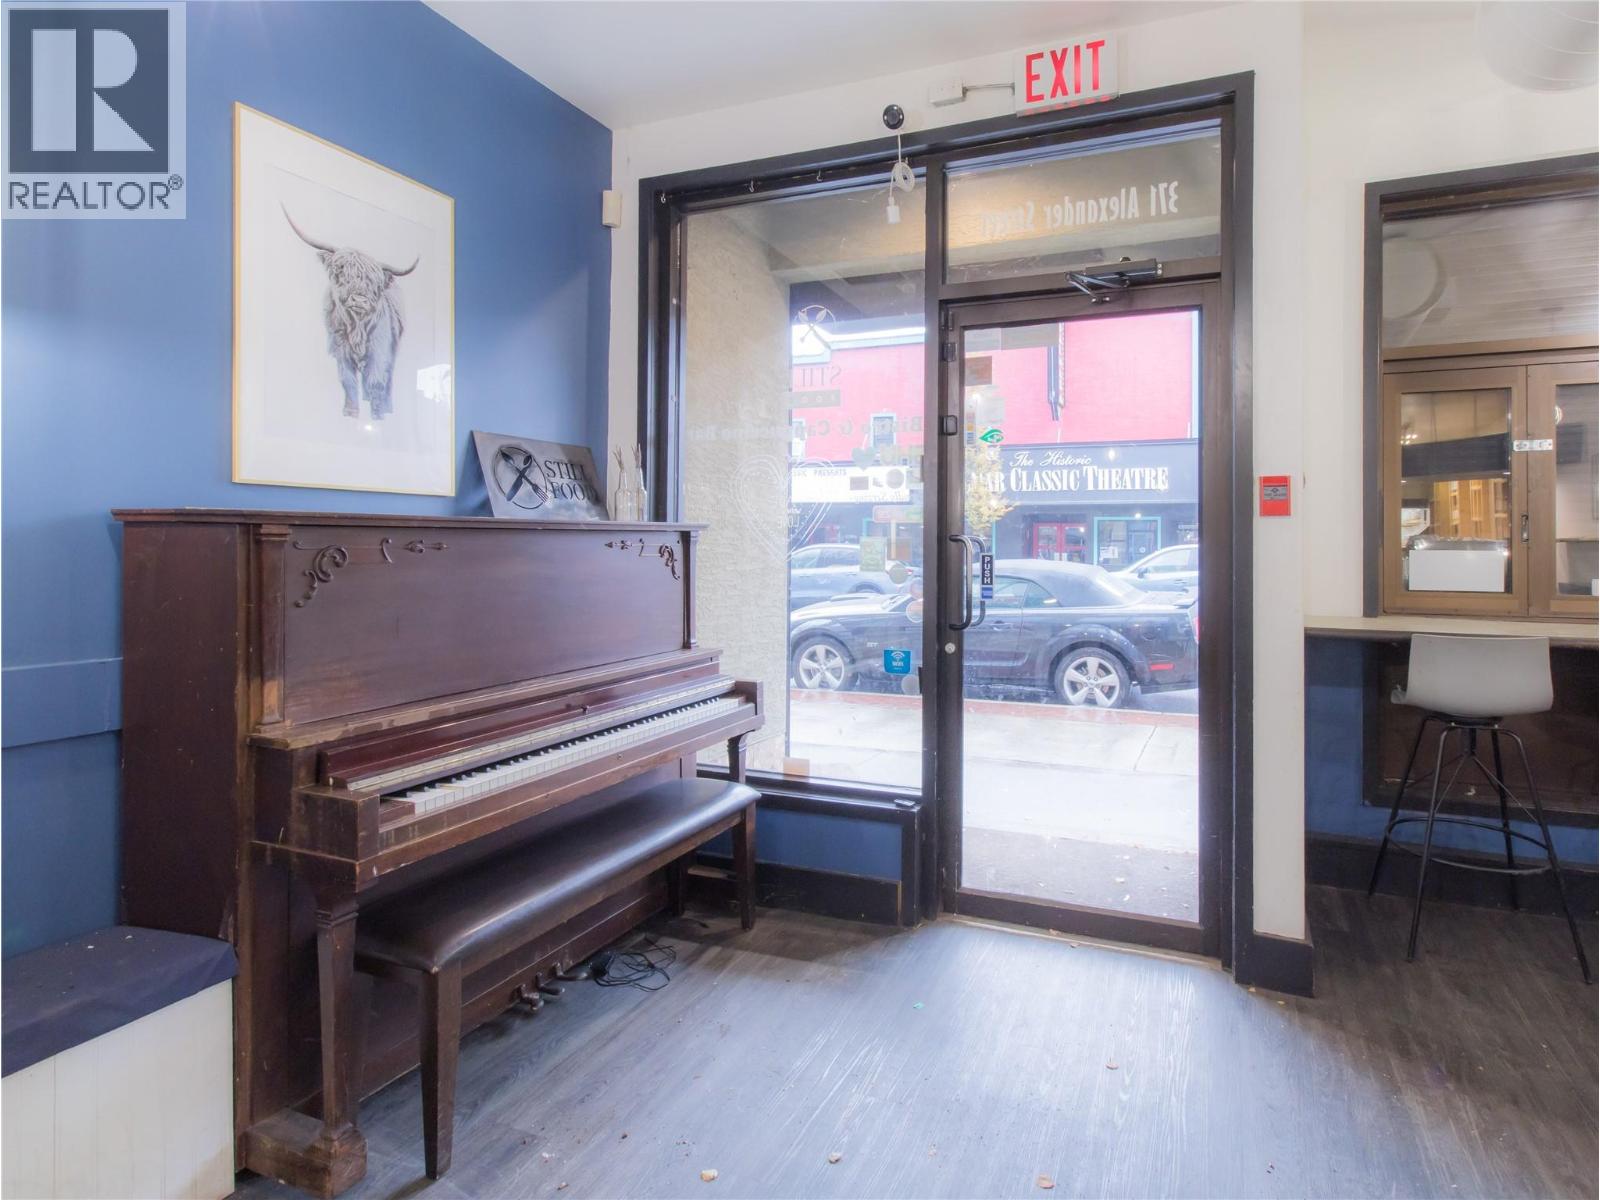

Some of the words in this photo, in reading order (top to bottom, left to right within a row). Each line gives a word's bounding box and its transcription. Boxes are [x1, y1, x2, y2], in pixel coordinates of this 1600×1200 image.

[1025, 40, 1105, 103] EXIT
[1009, 452, 1034, 467] The
[1039, 450, 1092, 467] Historic
[1010, 467, 1080, 492] CLASSIC
[1083, 465, 1169, 491] THEATRE
